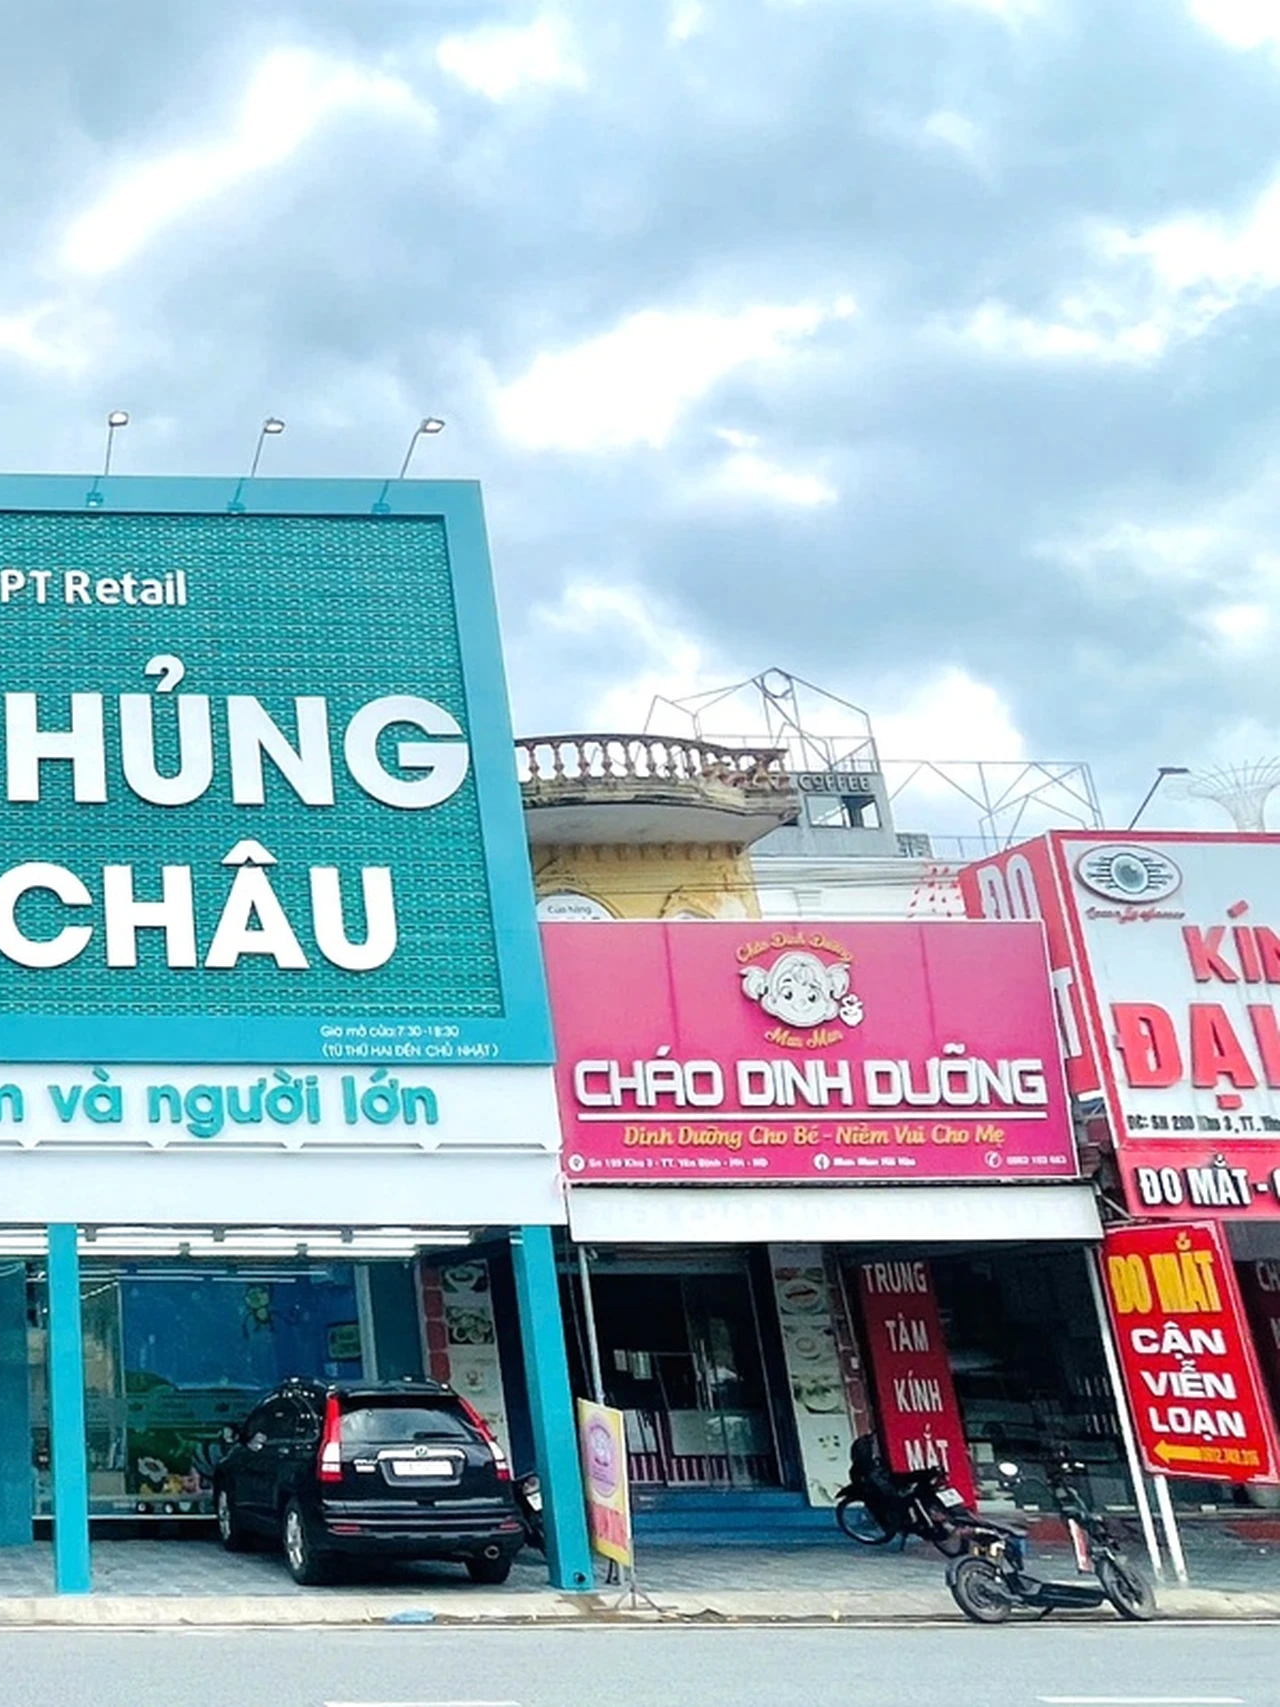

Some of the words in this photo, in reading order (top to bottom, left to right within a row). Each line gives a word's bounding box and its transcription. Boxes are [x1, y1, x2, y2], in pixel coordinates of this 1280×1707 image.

[64, 569, 188, 606] Retail
[798, 774, 871, 792] COFFEE
[371, 1044, 393, 1057] HAI
[573, 1045, 726, 1108] CHÁO
[737, 1059, 854, 1108] DINH
[866, 1042, 1048, 1107] DƯỠNG
[47, 1066, 124, 1123] và
[148, 1067, 321, 1138] người
[341, 1067, 439, 1125] lớn
[623, 1126, 673, 1147] Dinh
[677, 1126, 743, 1149] Dưỡng
[749, 1126, 787, 1146] Cho
[793, 1124, 820, 1145] Bé
[893, 1125, 926, 1145] Vui
[931, 1125, 972, 1146] Cho
[975, 1124, 1005, 1149] Mẹ
[1137, 1167, 1183, 1205] ĐO
[1186, 1153, 1252, 1205] MẮT
[861, 1261, 928, 1293] TRUNG
[1149, 1231, 1223, 1314] MẮT
[1131, 1320, 1228, 1360] CẬN
[893, 1369, 944, 1413] KÍNH
[1140, 1359, 1237, 1400] VIỄN
[1148, 1407, 1247, 1441] LOẠN
[904, 1423, 949, 1474] MẮT
